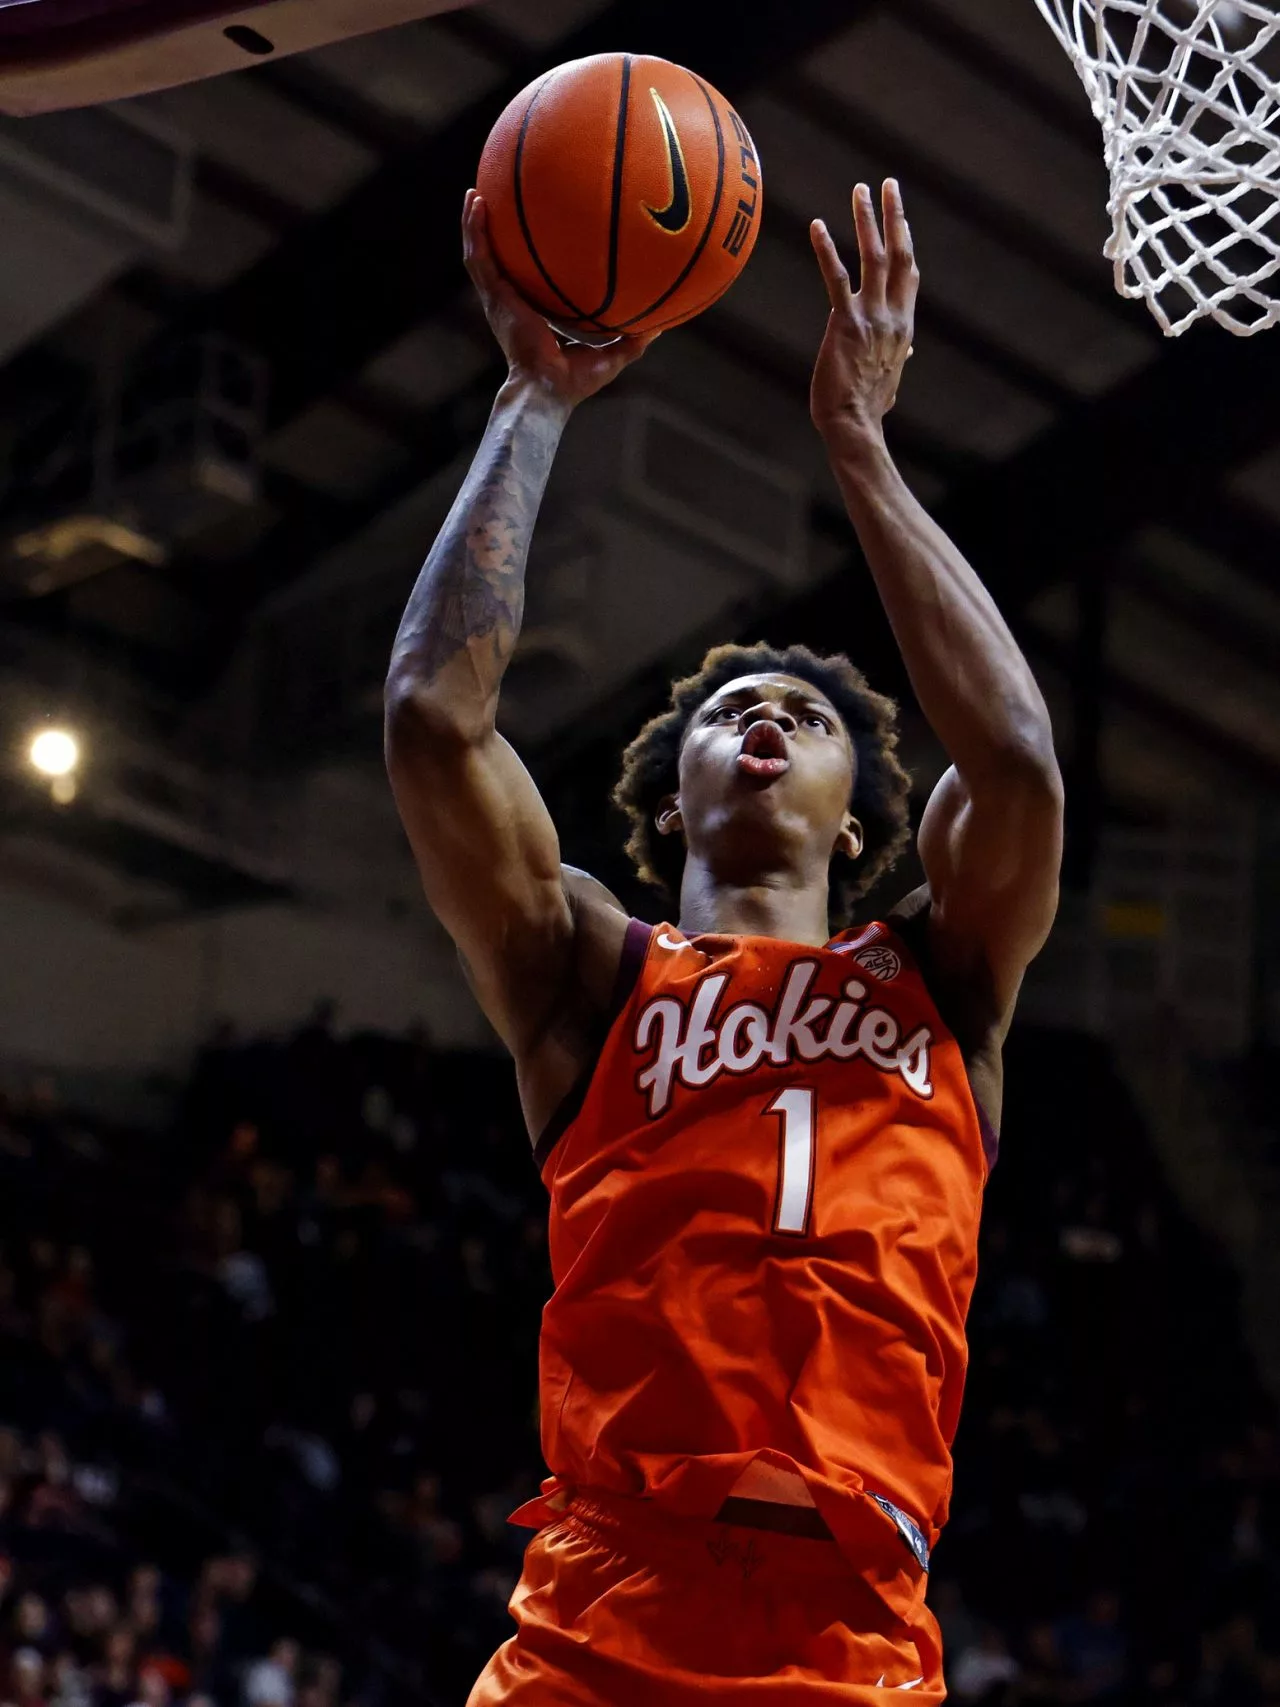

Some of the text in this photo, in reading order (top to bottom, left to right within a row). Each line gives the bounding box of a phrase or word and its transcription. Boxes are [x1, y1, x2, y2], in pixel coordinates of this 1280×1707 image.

[722, 110, 757, 258] ELITE
[634, 957, 934, 1121] Hokies
[761, 1085, 817, 1238] 1
